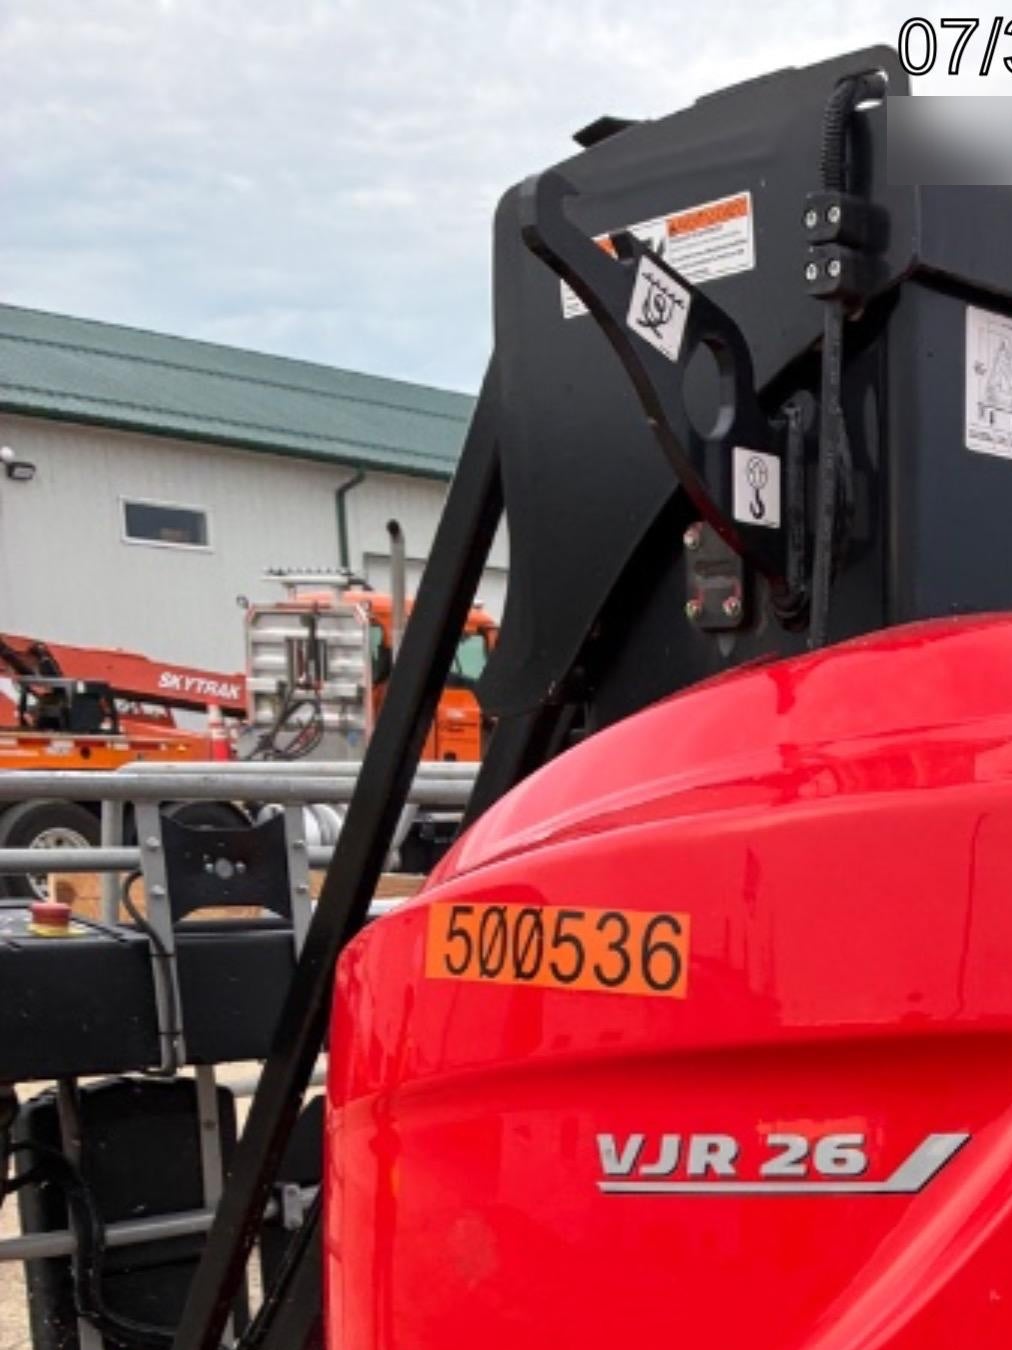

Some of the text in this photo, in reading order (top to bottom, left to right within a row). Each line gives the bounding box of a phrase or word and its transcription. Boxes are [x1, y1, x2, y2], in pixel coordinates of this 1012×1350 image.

[158, 671, 241, 700] SKYTRAK
[444, 905, 683, 991] 500536
[596, 1133, 869, 1177] VJR 26
